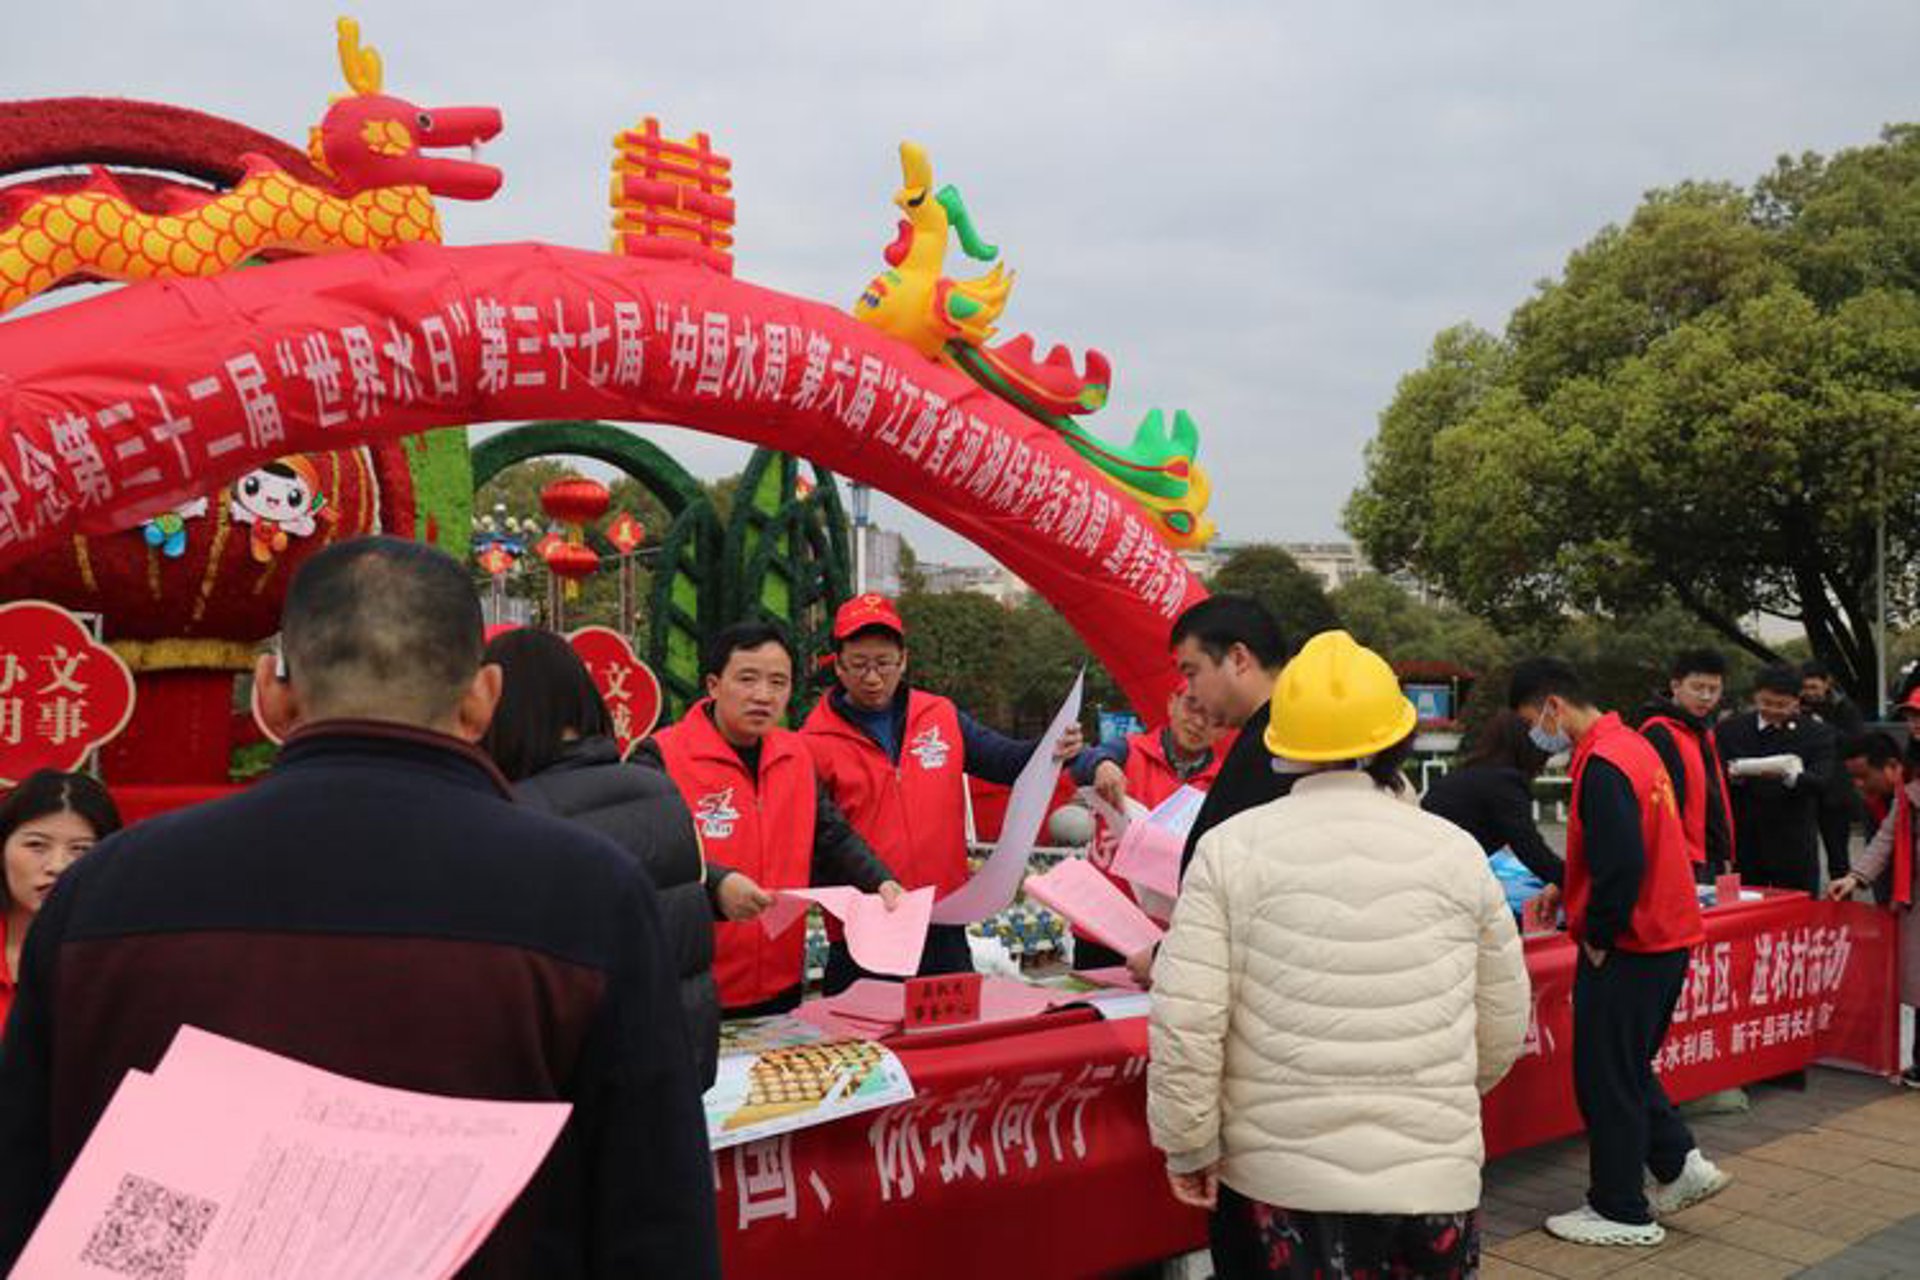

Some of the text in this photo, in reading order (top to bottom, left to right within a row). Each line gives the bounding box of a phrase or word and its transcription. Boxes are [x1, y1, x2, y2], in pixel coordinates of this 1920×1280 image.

[712, 1056, 1147, 1230] 国、你我同行”
